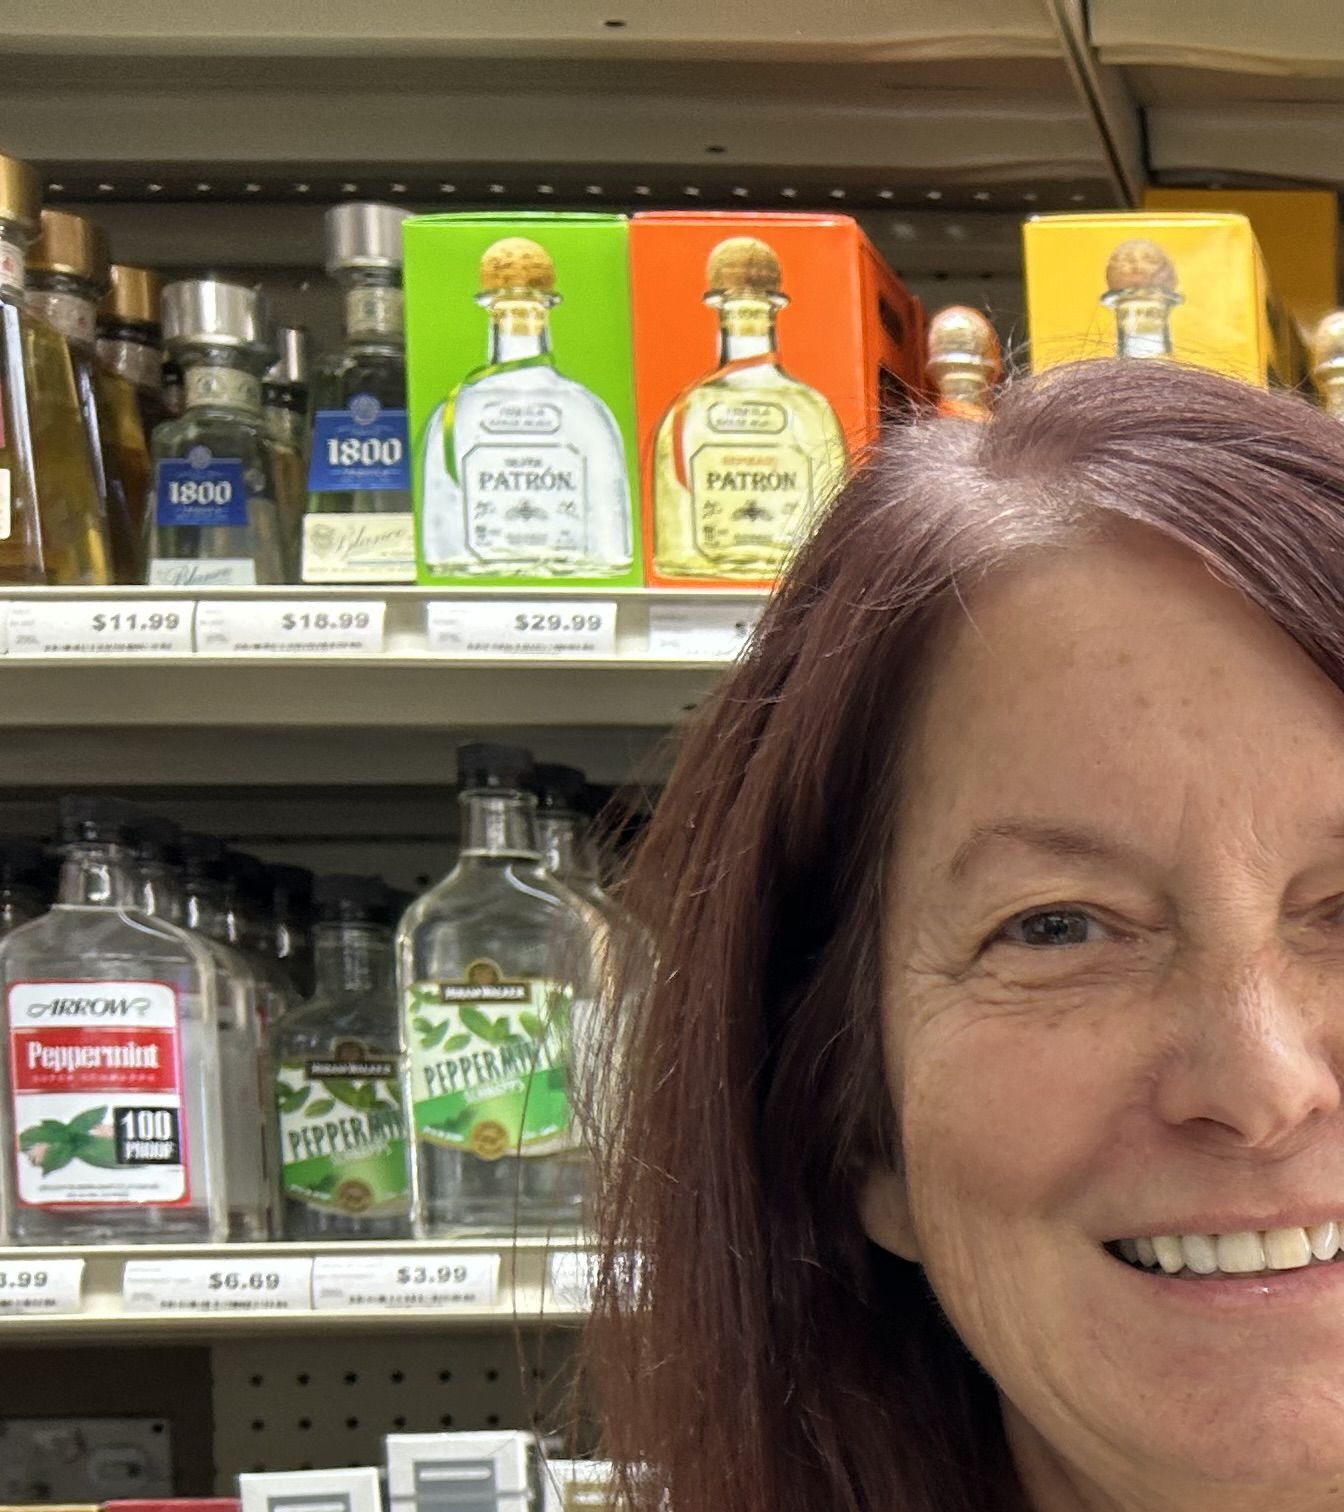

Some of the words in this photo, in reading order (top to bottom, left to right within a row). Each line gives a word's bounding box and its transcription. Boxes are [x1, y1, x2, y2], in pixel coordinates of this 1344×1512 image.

[327, 437, 401, 466] 1800
[169, 481, 231, 503] 1800
[92, 613, 181, 632] $11.99
[282, 612, 370, 631] $18.99
[515, 613, 602, 632] $29.99
[26, 997, 151, 1018] ARROW
[26, 1041, 160, 1073] Peppermint
[120, 1109, 174, 1141] 100
[126, 1141, 174, 1161] PROOF
[208, 1272, 280, 1290] $6.69
[396, 1265, 468, 1284] $3.99
